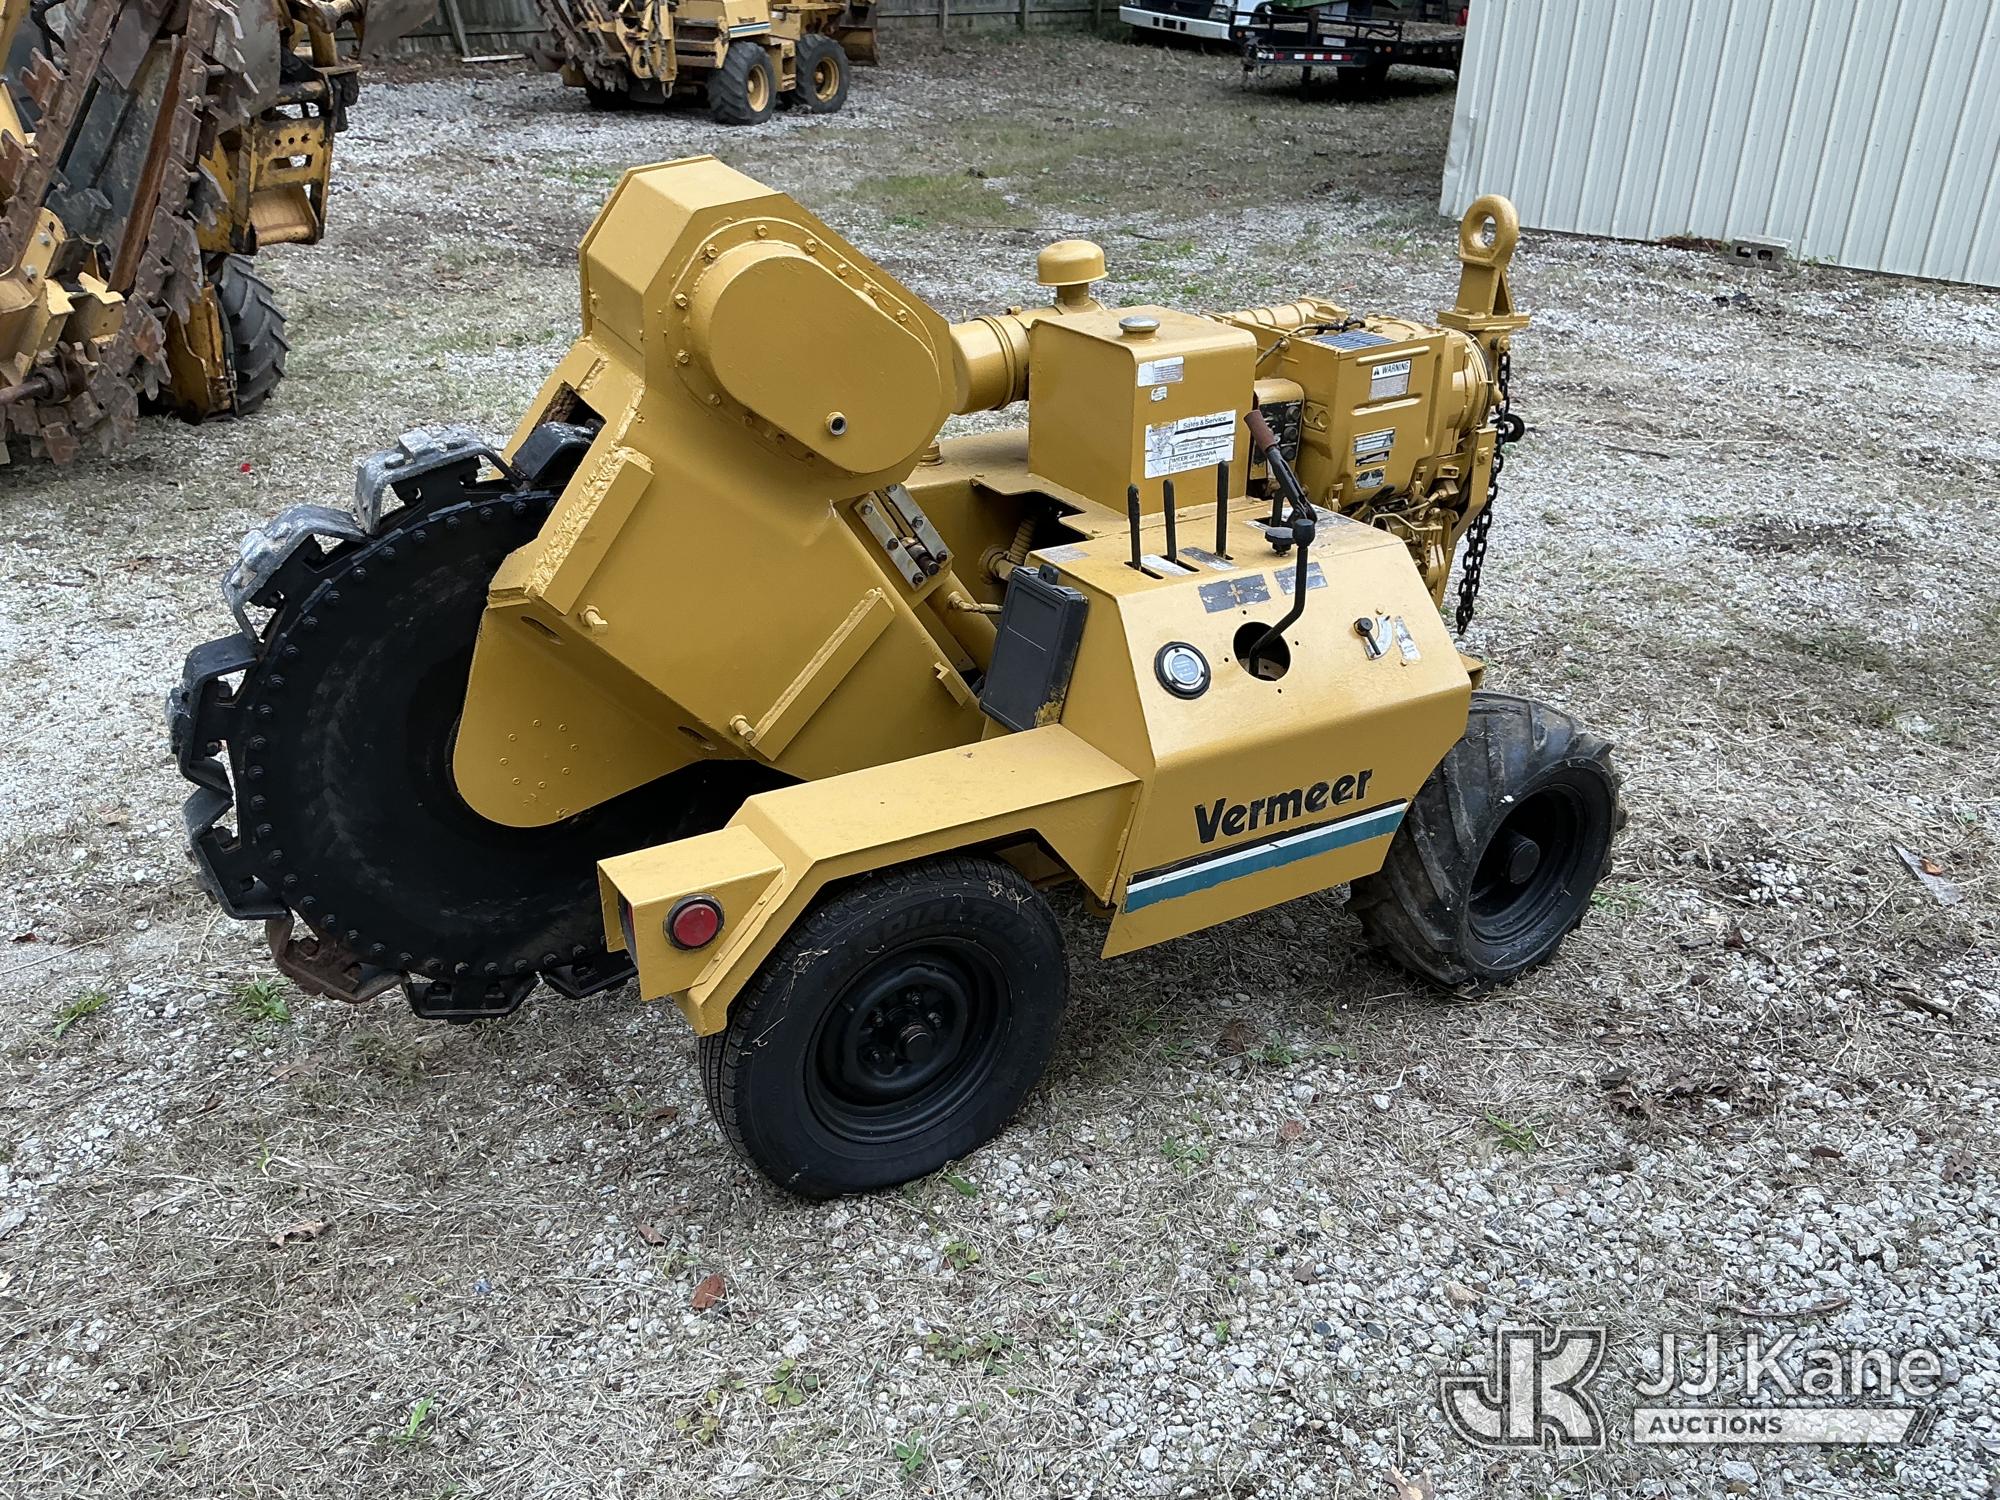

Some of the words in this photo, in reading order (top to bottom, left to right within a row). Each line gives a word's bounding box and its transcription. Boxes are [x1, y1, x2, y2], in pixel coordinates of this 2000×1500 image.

[1382, 361, 1409, 374] WARNING
[1205, 416, 1226, 424] Service
[1195, 450, 1217, 458] INDIANA
[1194, 769, 1373, 843] Vermeer
